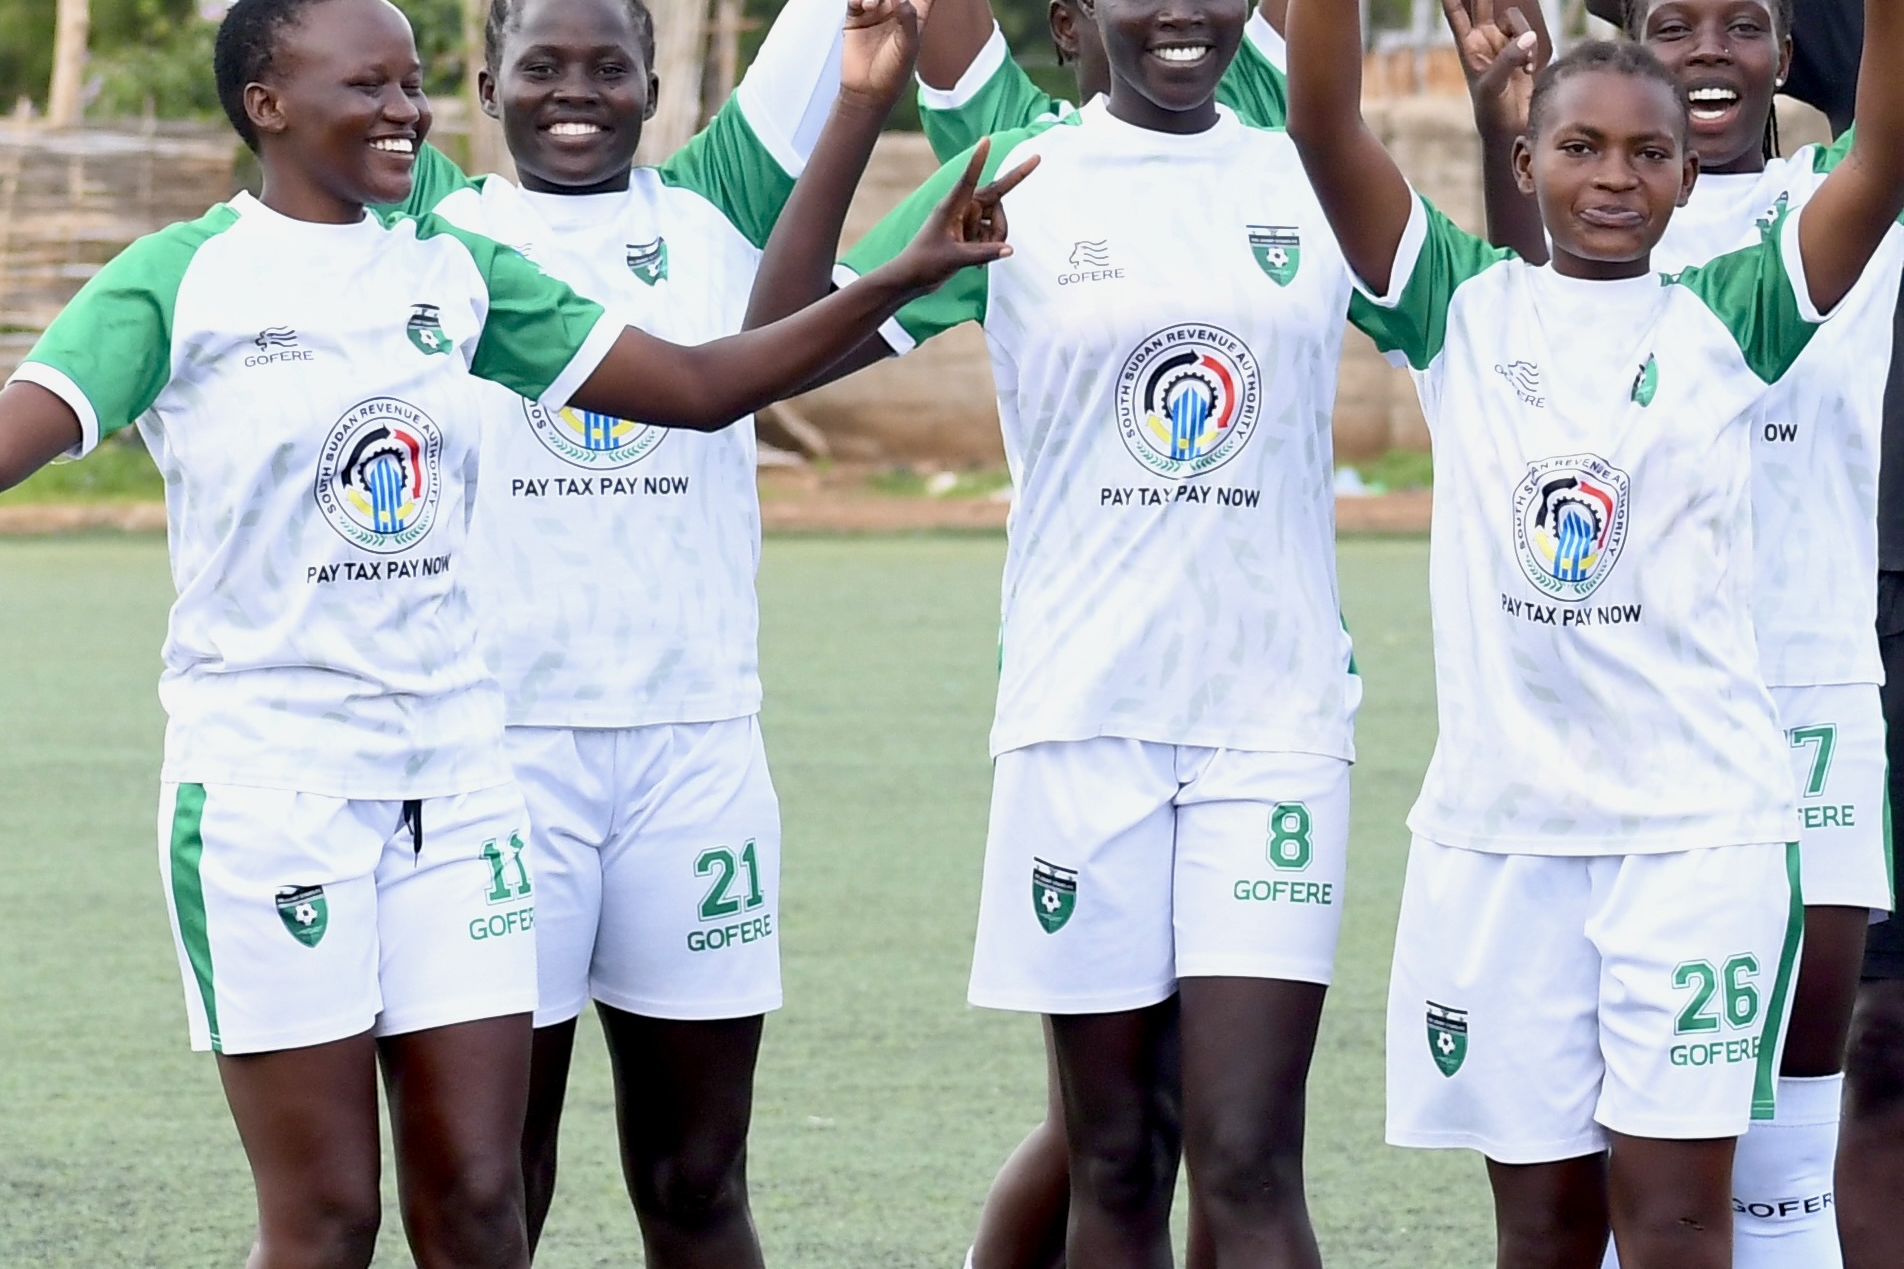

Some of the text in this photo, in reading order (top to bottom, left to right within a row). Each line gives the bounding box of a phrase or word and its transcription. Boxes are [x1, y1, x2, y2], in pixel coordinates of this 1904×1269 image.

[1057, 268, 1126, 286] GOFERE
[244, 349, 314, 368] GOFERE
[1120, 328, 1257, 441] SOUTH SUDAN REVENUE AUTHORITY
[1762, 424, 1798, 443] OW
[318, 402, 440, 515] SOUTH SUDAN REVENUE AUTHORITY
[512, 476, 690, 497] PAY TAX PAY NOW
[1101, 487, 1134, 507] PAY
[1174, 484, 1212, 504] PAY
[1216, 487, 1261, 509] NOW
[307, 553, 452, 584] PAY TAX PAY NOW
[1501, 593, 1642, 627] PAY TAX PAY NOW
[1784, 723, 1837, 798] 7
[1797, 805, 1855, 828] ERE
[1265, 801, 1313, 872] 8
[480, 828, 533, 906] 11
[693, 837, 765, 923] 21
[1234, 880, 1333, 906] GOFERE
[686, 914, 773, 952] GOFERE
[1671, 951, 1760, 1036] 26
[1670, 1036, 1759, 1066] GOFERE
